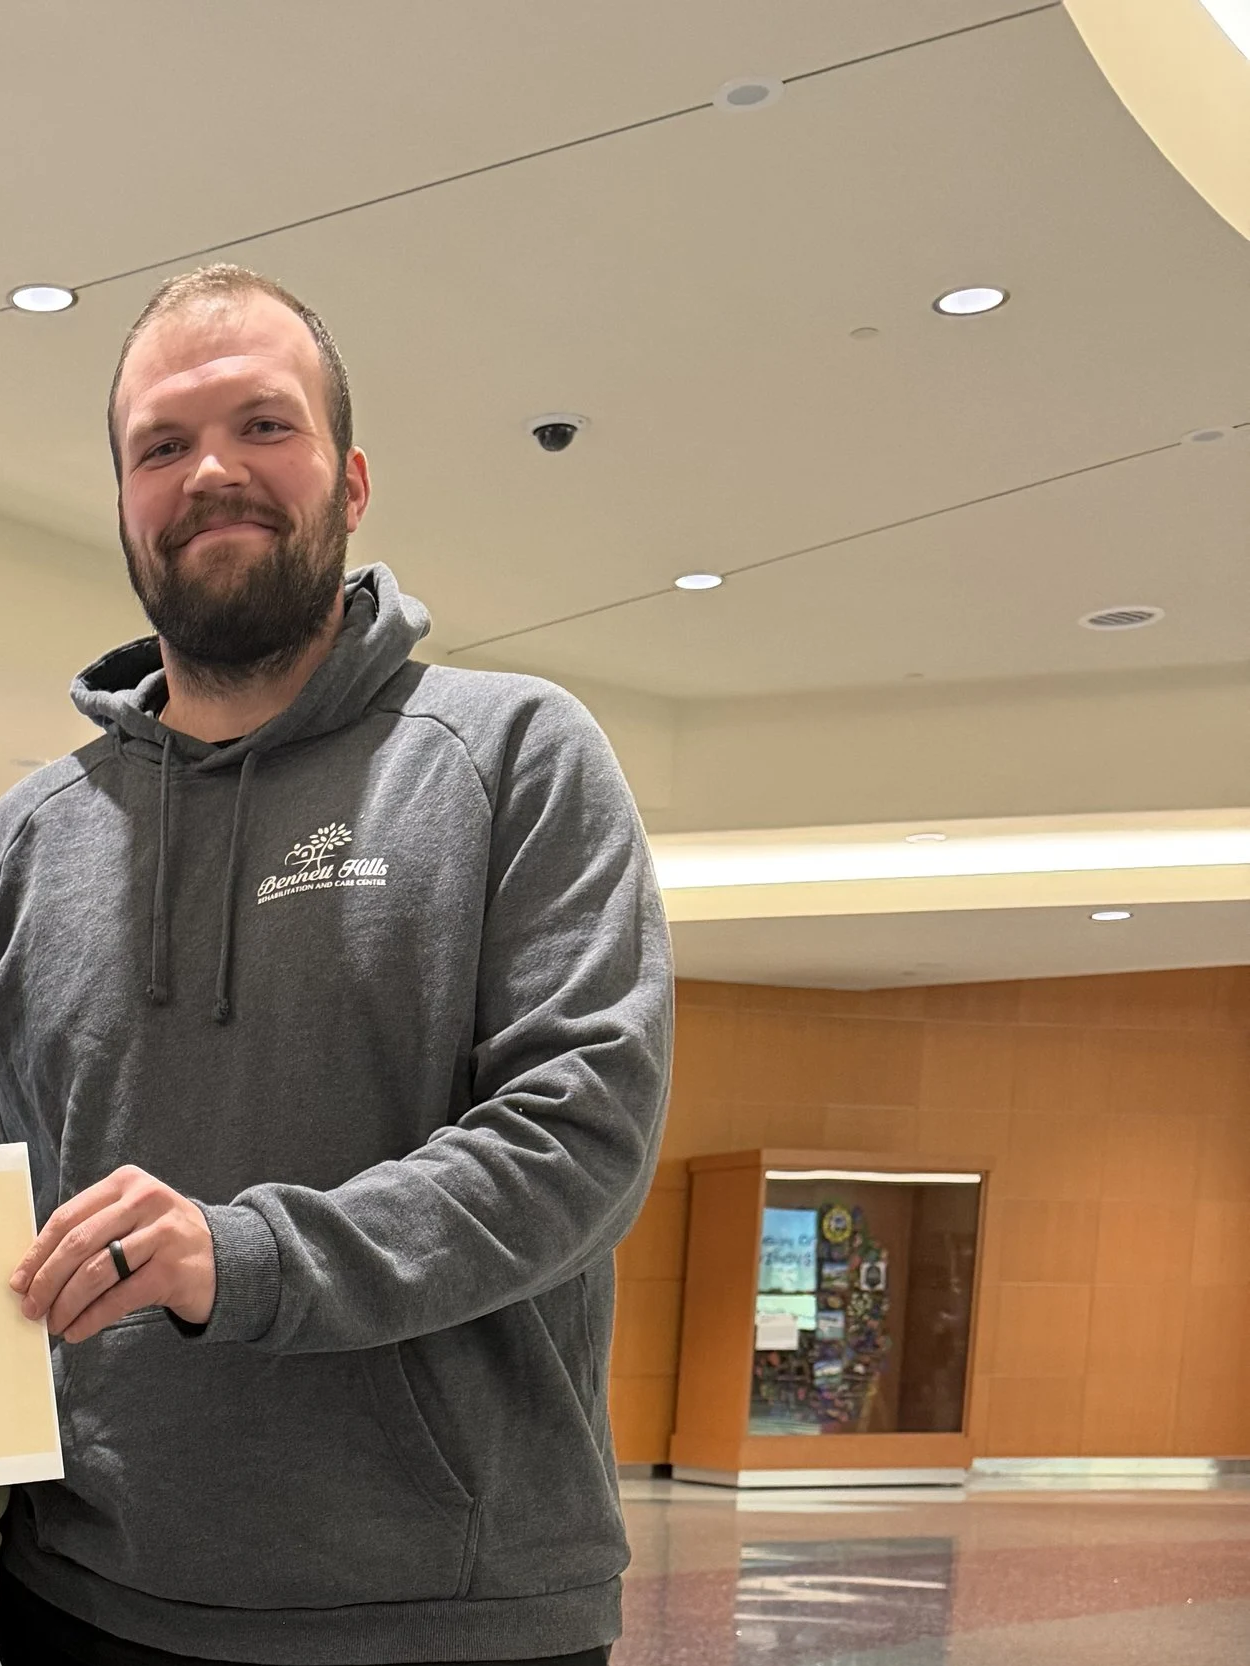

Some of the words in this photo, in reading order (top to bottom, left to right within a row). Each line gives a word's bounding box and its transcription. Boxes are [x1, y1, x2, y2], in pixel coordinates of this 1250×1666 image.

[257, 864, 335, 897] Bennett
[338, 857, 389, 879] Hills
[257, 884, 314, 905] REHABILITATION
[315, 881, 333, 890] AND
[334, 879, 355, 887] CARE
[356, 878, 386, 886] CENTER
